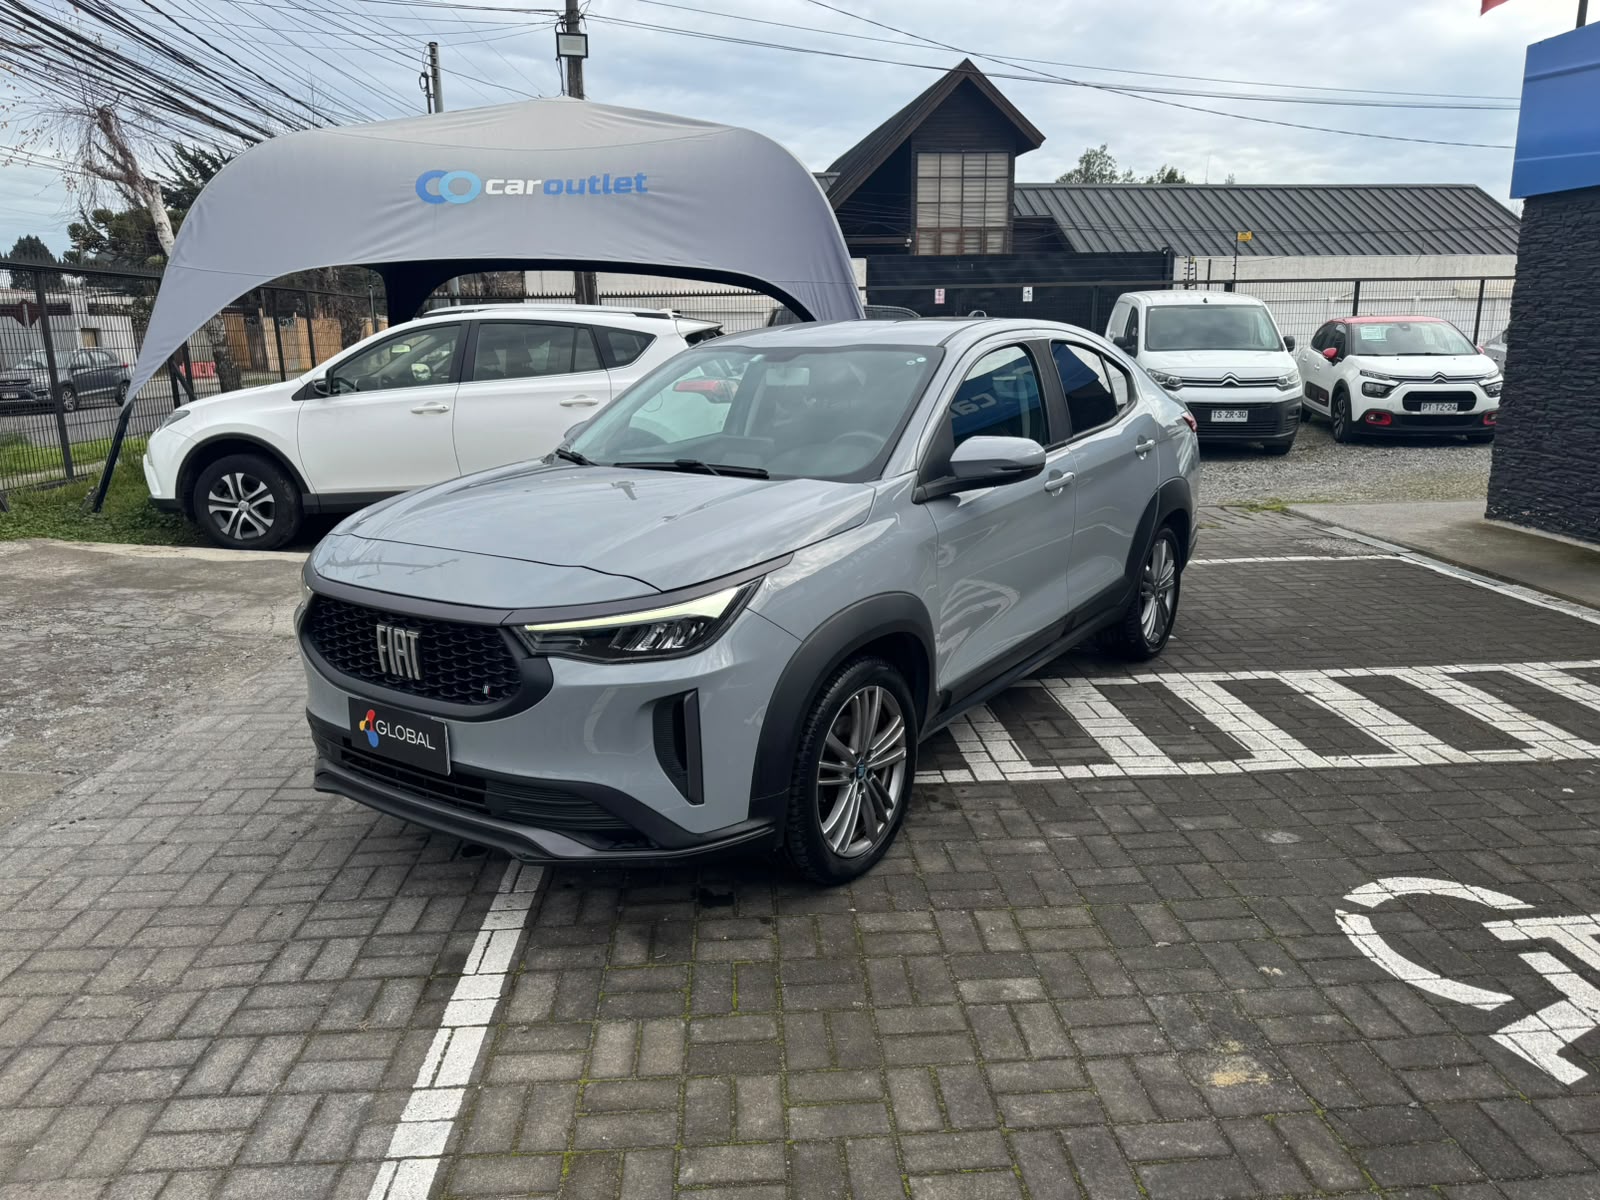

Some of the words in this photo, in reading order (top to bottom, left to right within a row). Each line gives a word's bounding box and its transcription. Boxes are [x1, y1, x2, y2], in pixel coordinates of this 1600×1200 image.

[485, 172, 648, 195] caroutlet
[376, 624, 421, 680] FIAT
[375, 719, 436, 750] GLOBAL
